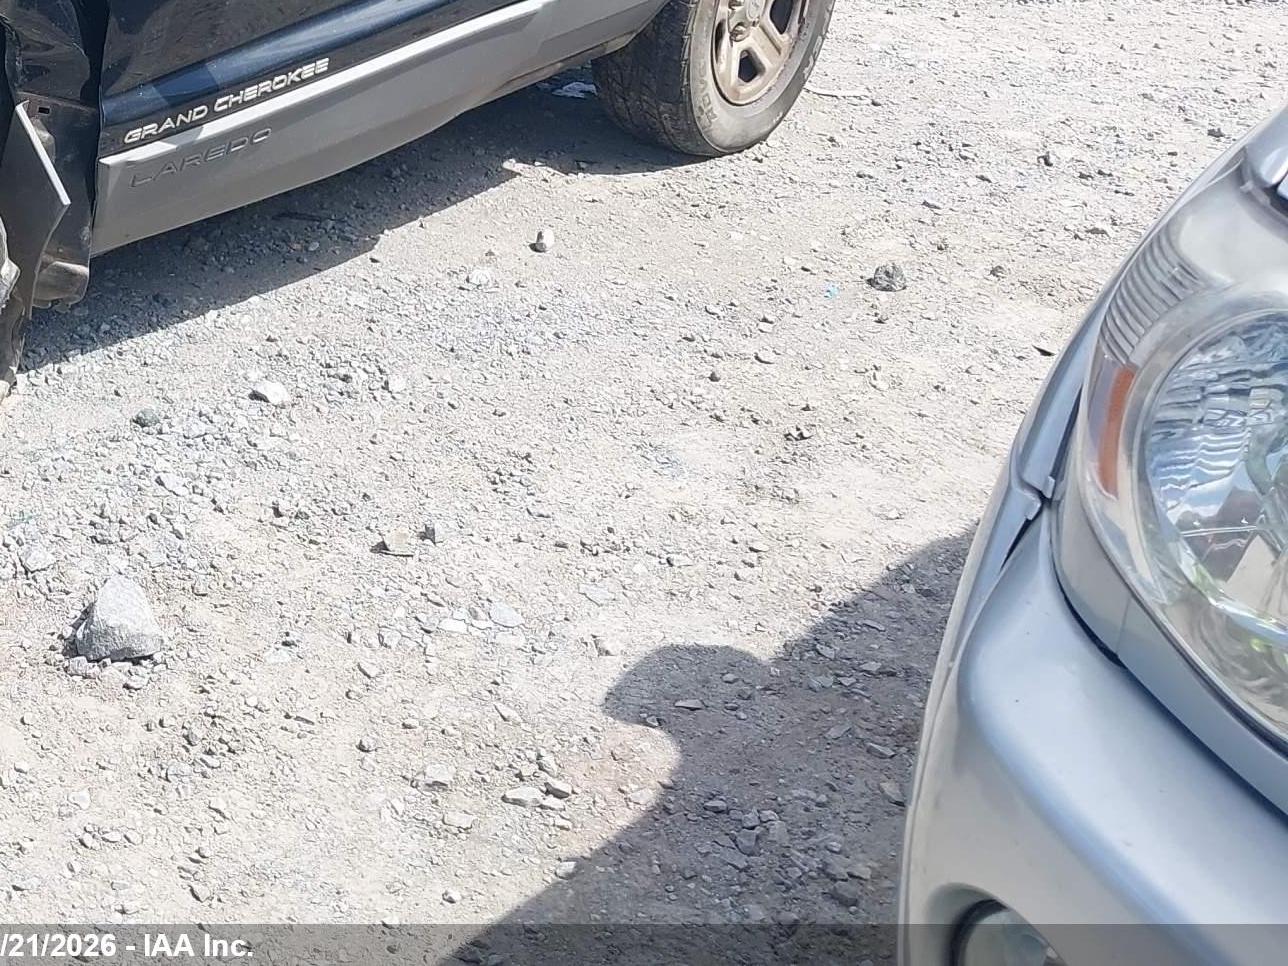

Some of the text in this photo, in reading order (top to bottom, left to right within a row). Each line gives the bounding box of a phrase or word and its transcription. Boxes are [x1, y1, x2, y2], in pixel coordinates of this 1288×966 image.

[124, 58, 329, 143] GRAND CHEROKEE
[130, 127, 272, 188] LAREDO
